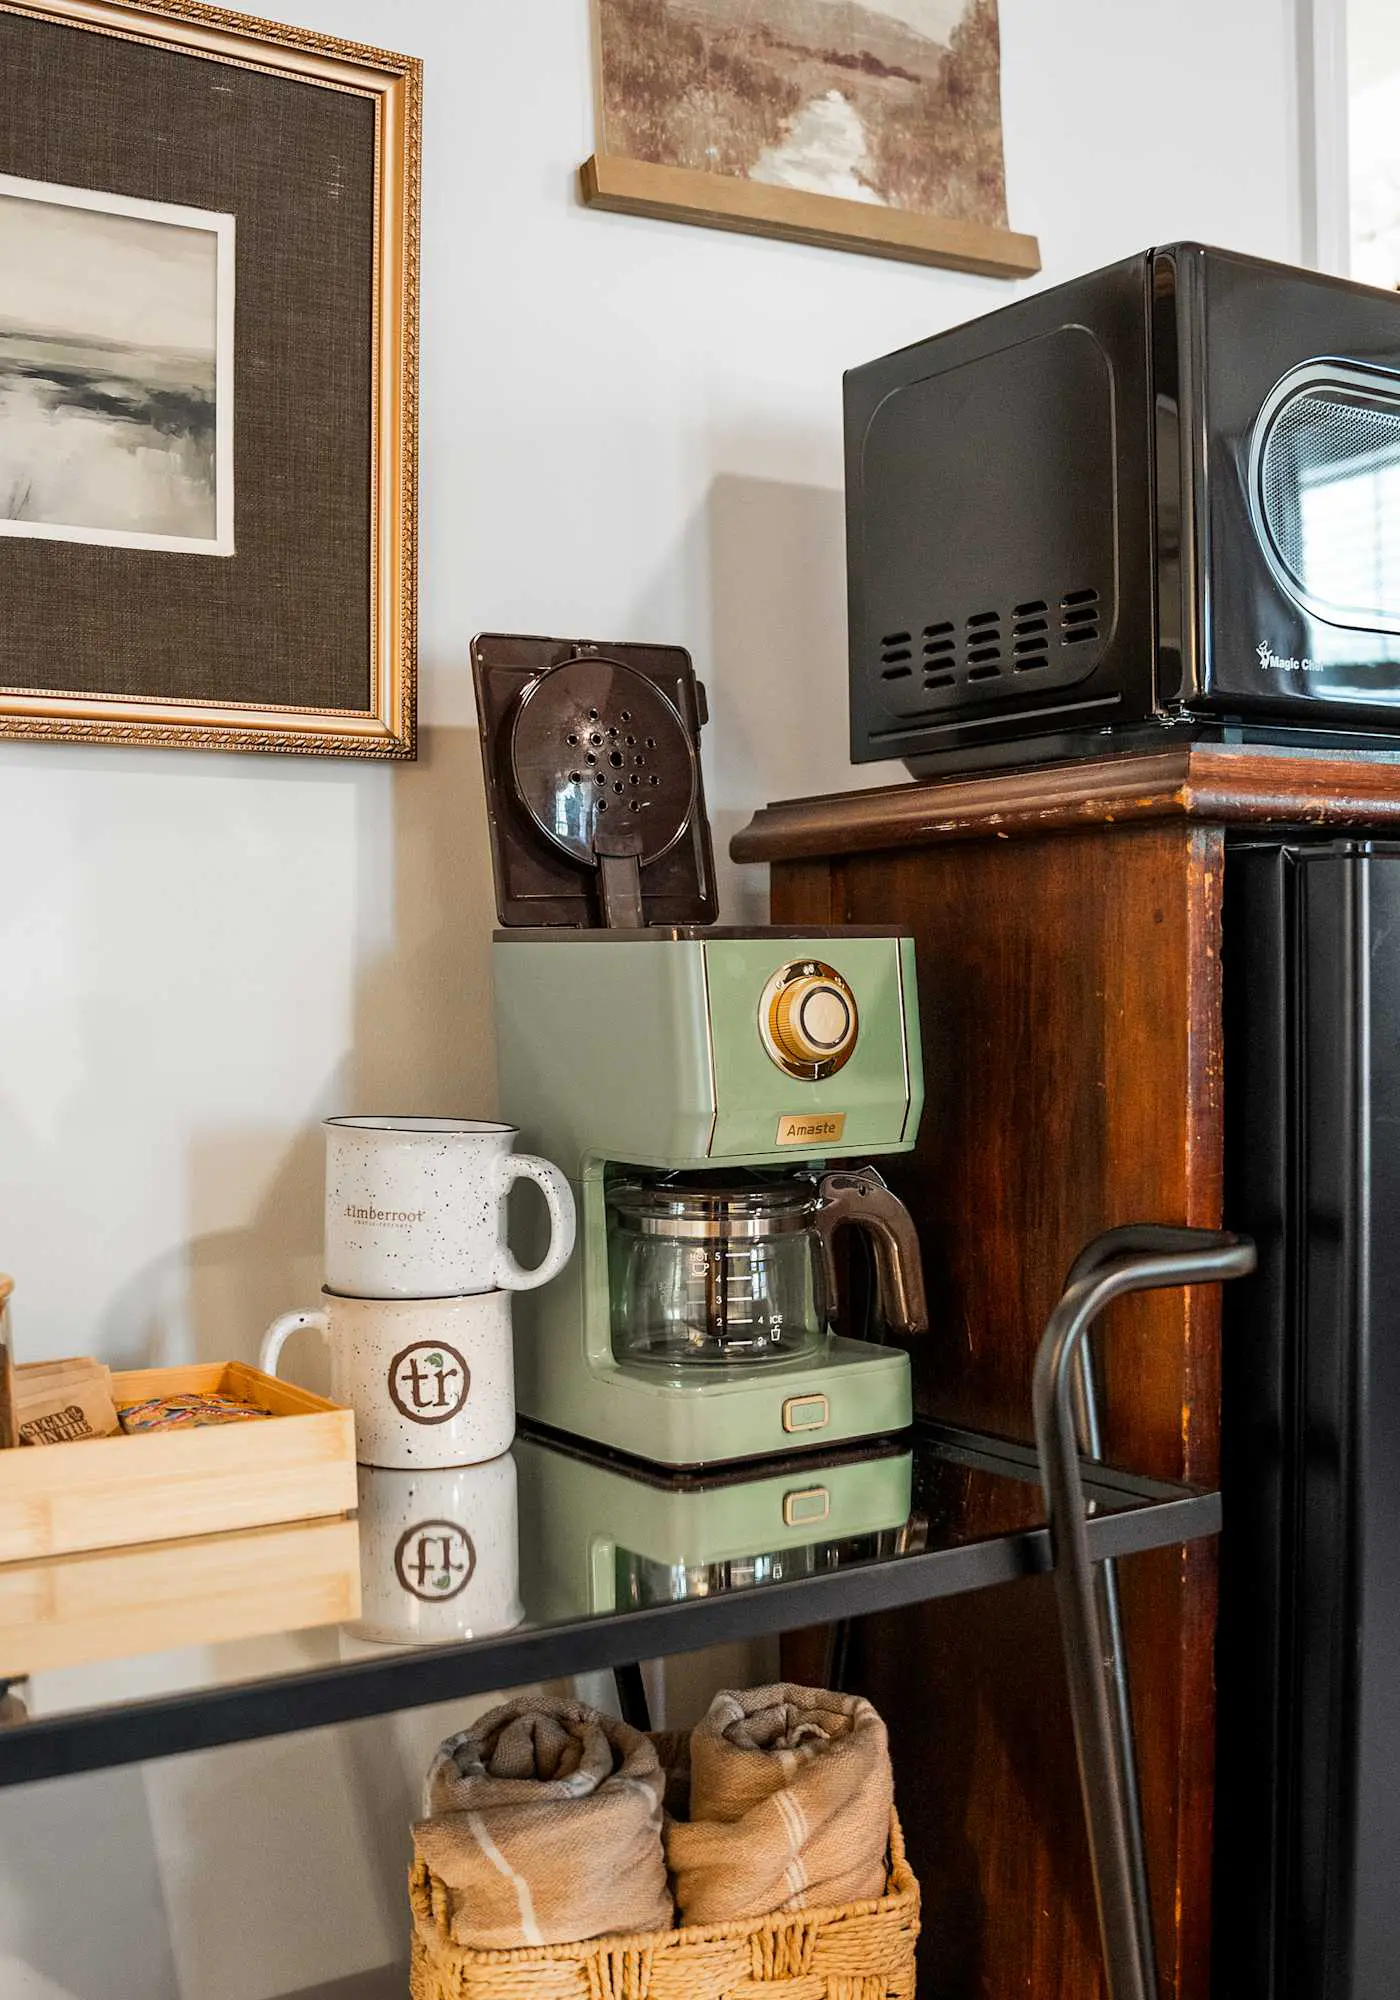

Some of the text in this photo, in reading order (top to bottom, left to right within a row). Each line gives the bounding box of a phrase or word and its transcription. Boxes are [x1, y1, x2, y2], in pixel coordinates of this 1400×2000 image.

[1269, 656, 1299, 671] Magic
[786, 1122, 837, 1137] Amaste
[346, 1203, 423, 1222] timberroot
[715, 1252, 721, 1261] 5
[715, 1274, 721, 1283] 4
[716, 1295, 722, 1304] 3
[716, 1315, 764, 1327] 2 4
[769, 1314, 783, 1324] ICE
[401, 1358, 458, 1408] tr
[21, 1411, 76, 1438] SUGAR
[38, 1429, 59, 1445] IN
[58, 1420, 91, 1441] THE
